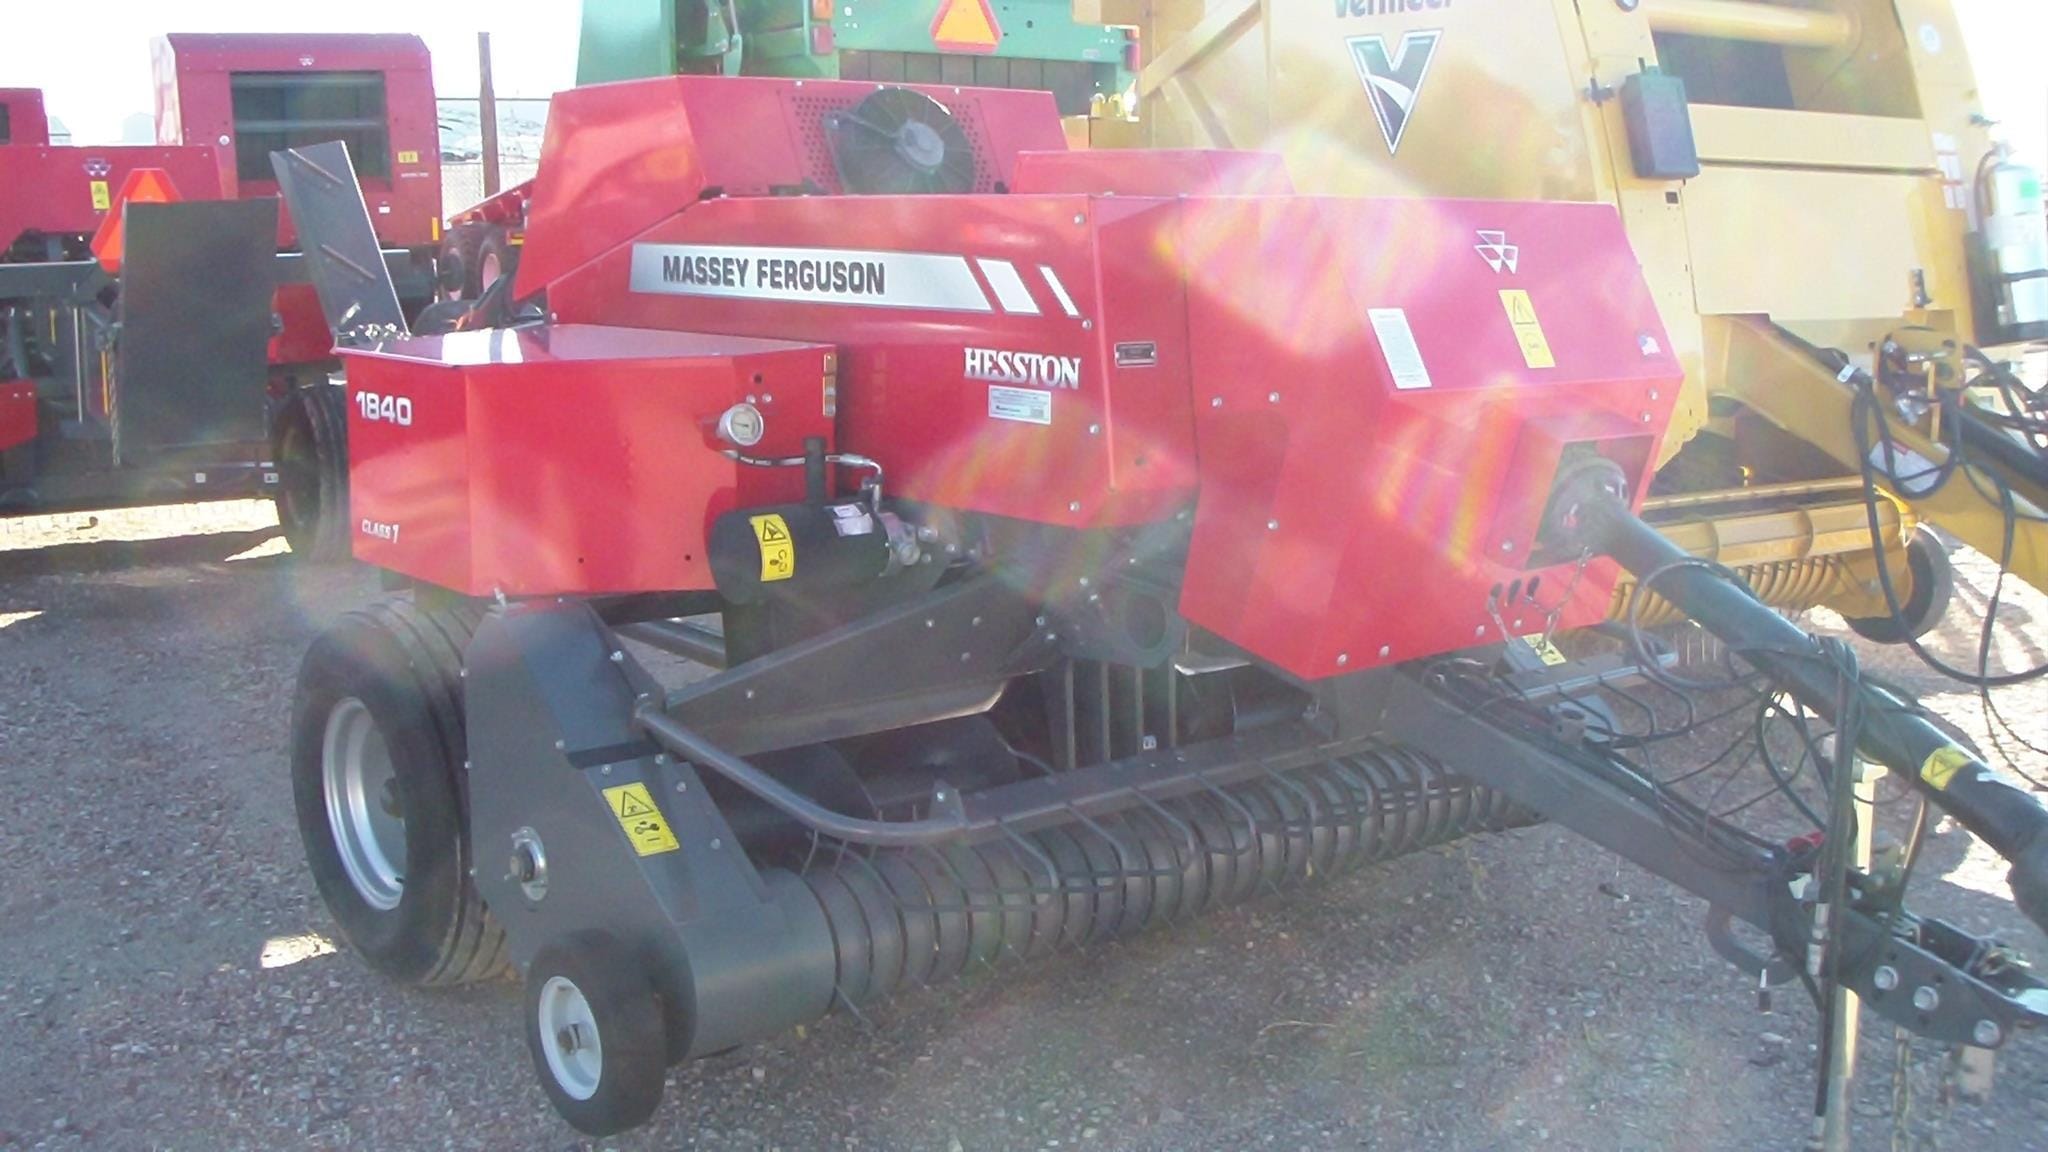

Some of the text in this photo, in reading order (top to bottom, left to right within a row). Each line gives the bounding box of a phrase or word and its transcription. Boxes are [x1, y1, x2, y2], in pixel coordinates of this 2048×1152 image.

[663, 255, 885, 295] MASSEY FERGUSON
[964, 347, 1081, 389] HESSTON
[355, 390, 412, 426] 1840
[362, 519, 399, 544] CLASS 1
